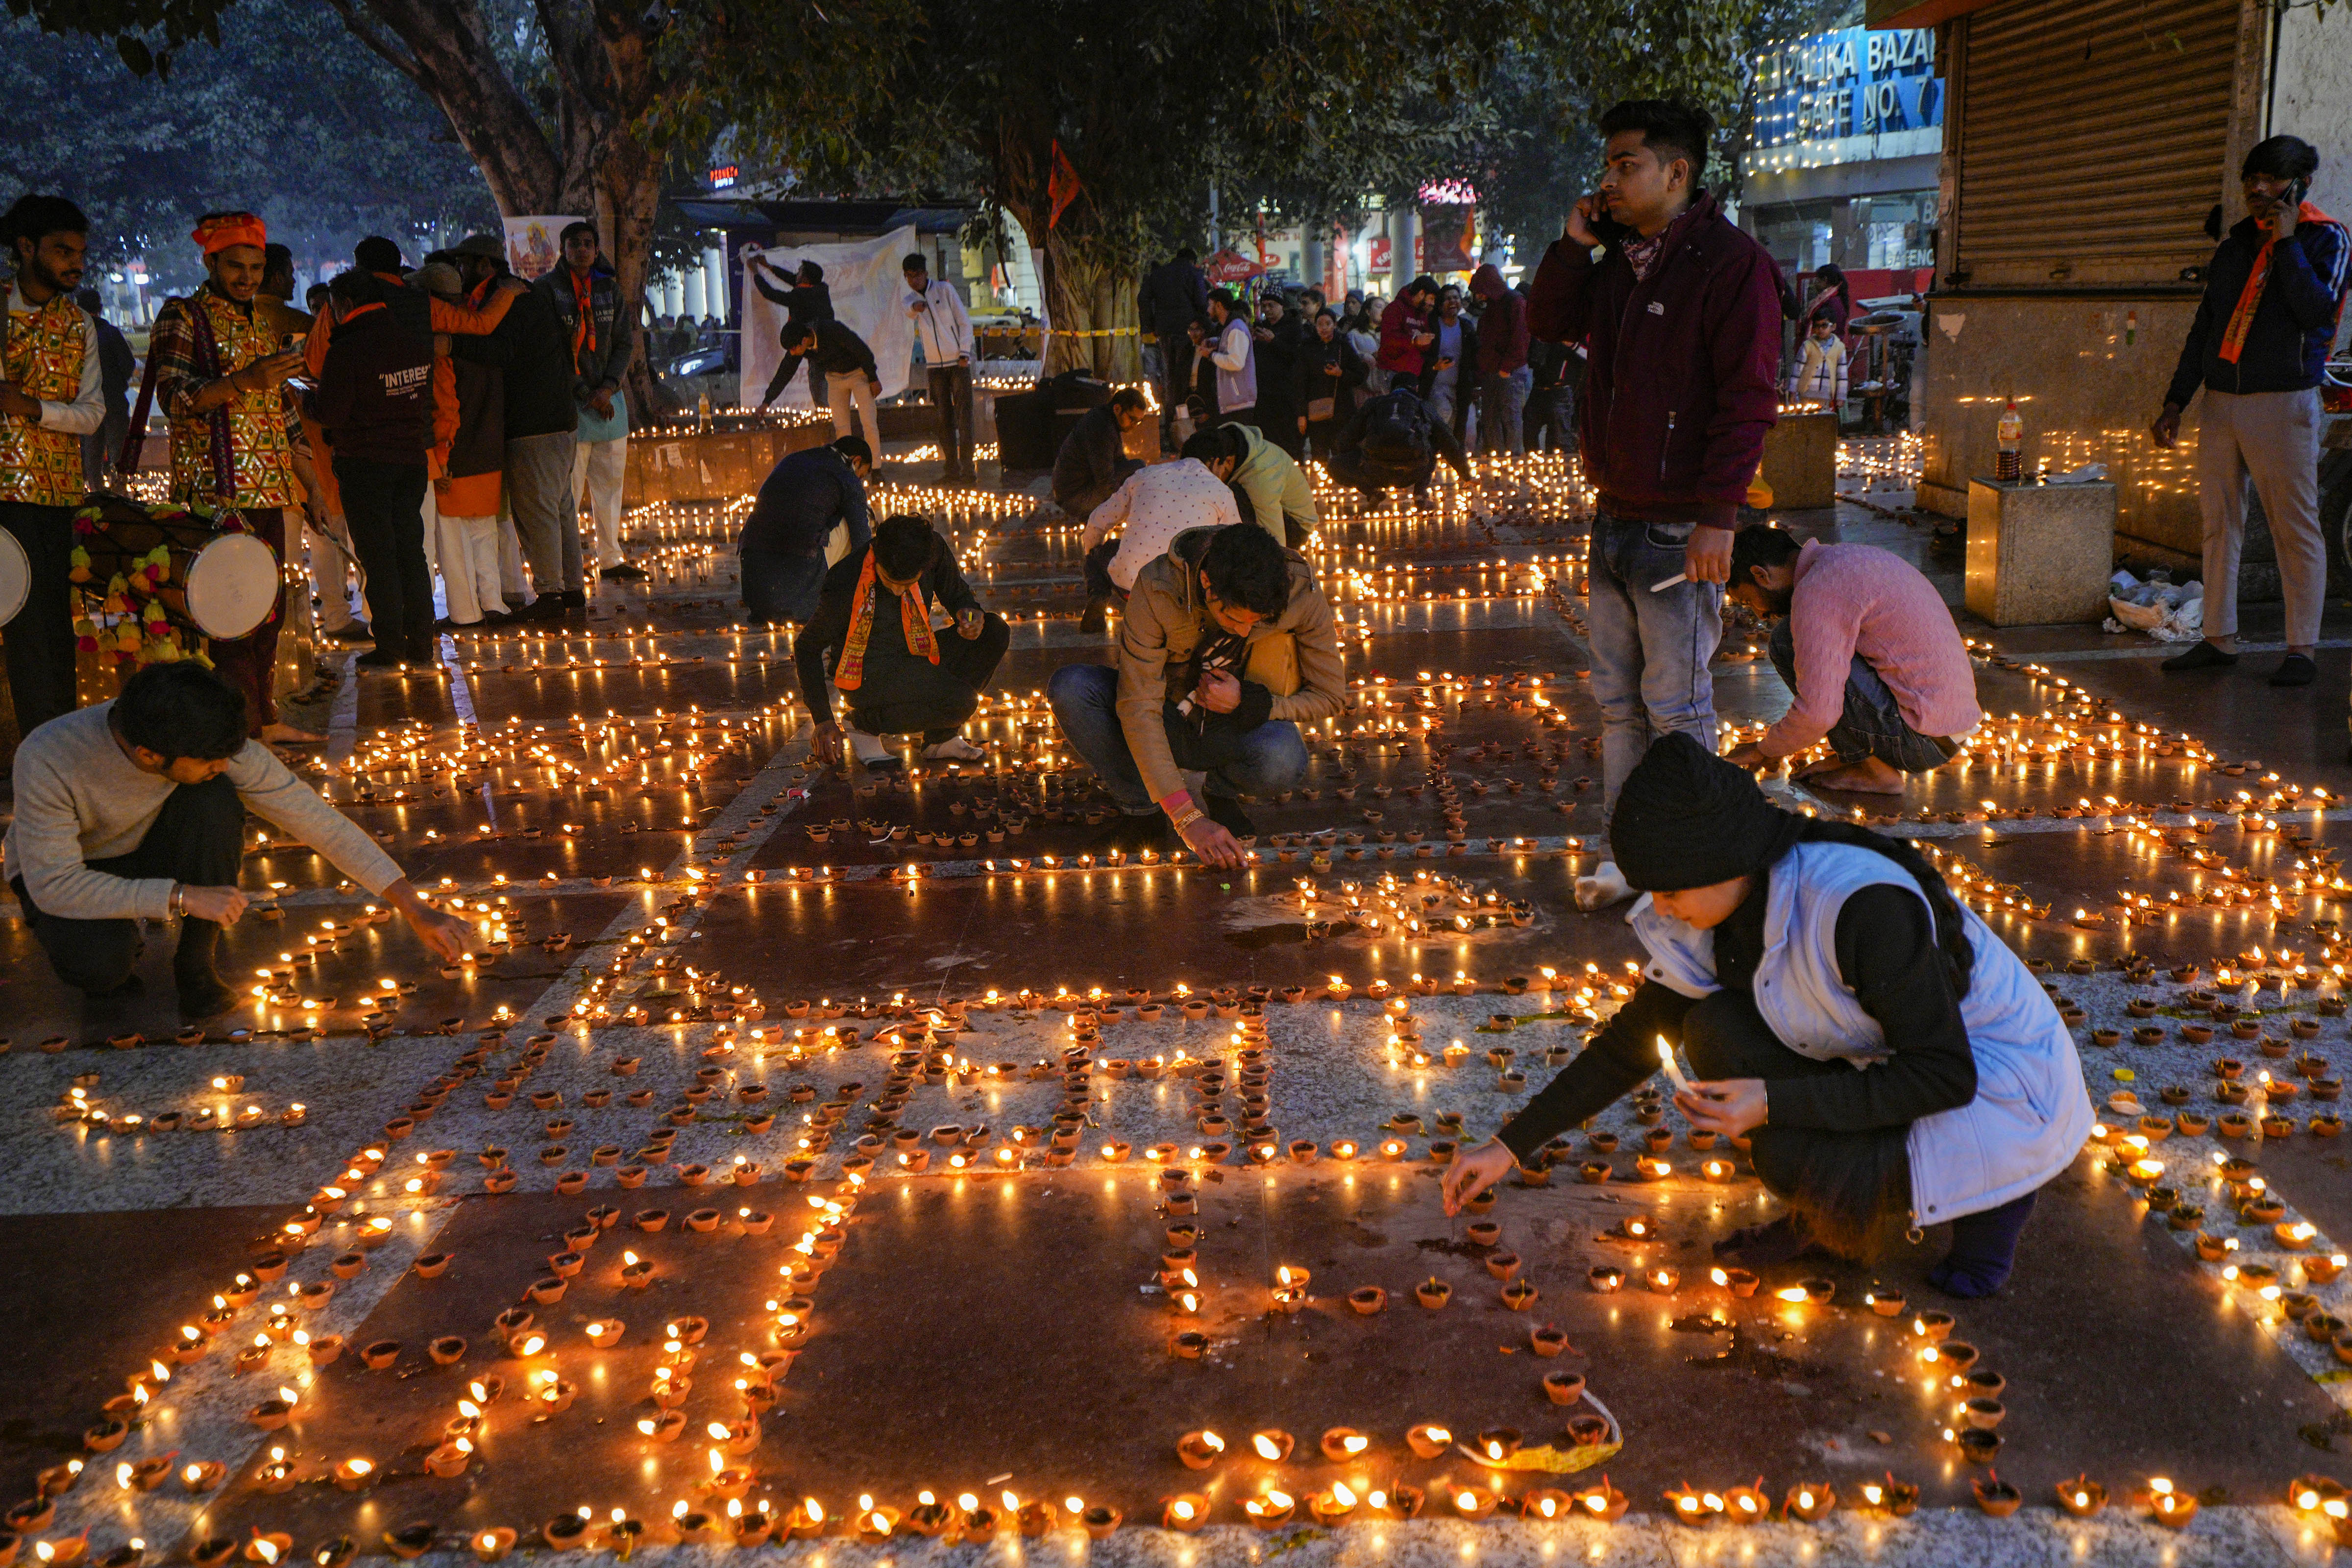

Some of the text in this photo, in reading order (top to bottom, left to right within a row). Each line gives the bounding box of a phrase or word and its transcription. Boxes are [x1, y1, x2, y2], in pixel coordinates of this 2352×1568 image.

[1782, 40, 1860, 86] PALIKA
[1797, 75, 1929, 128] GATE NO. 7
